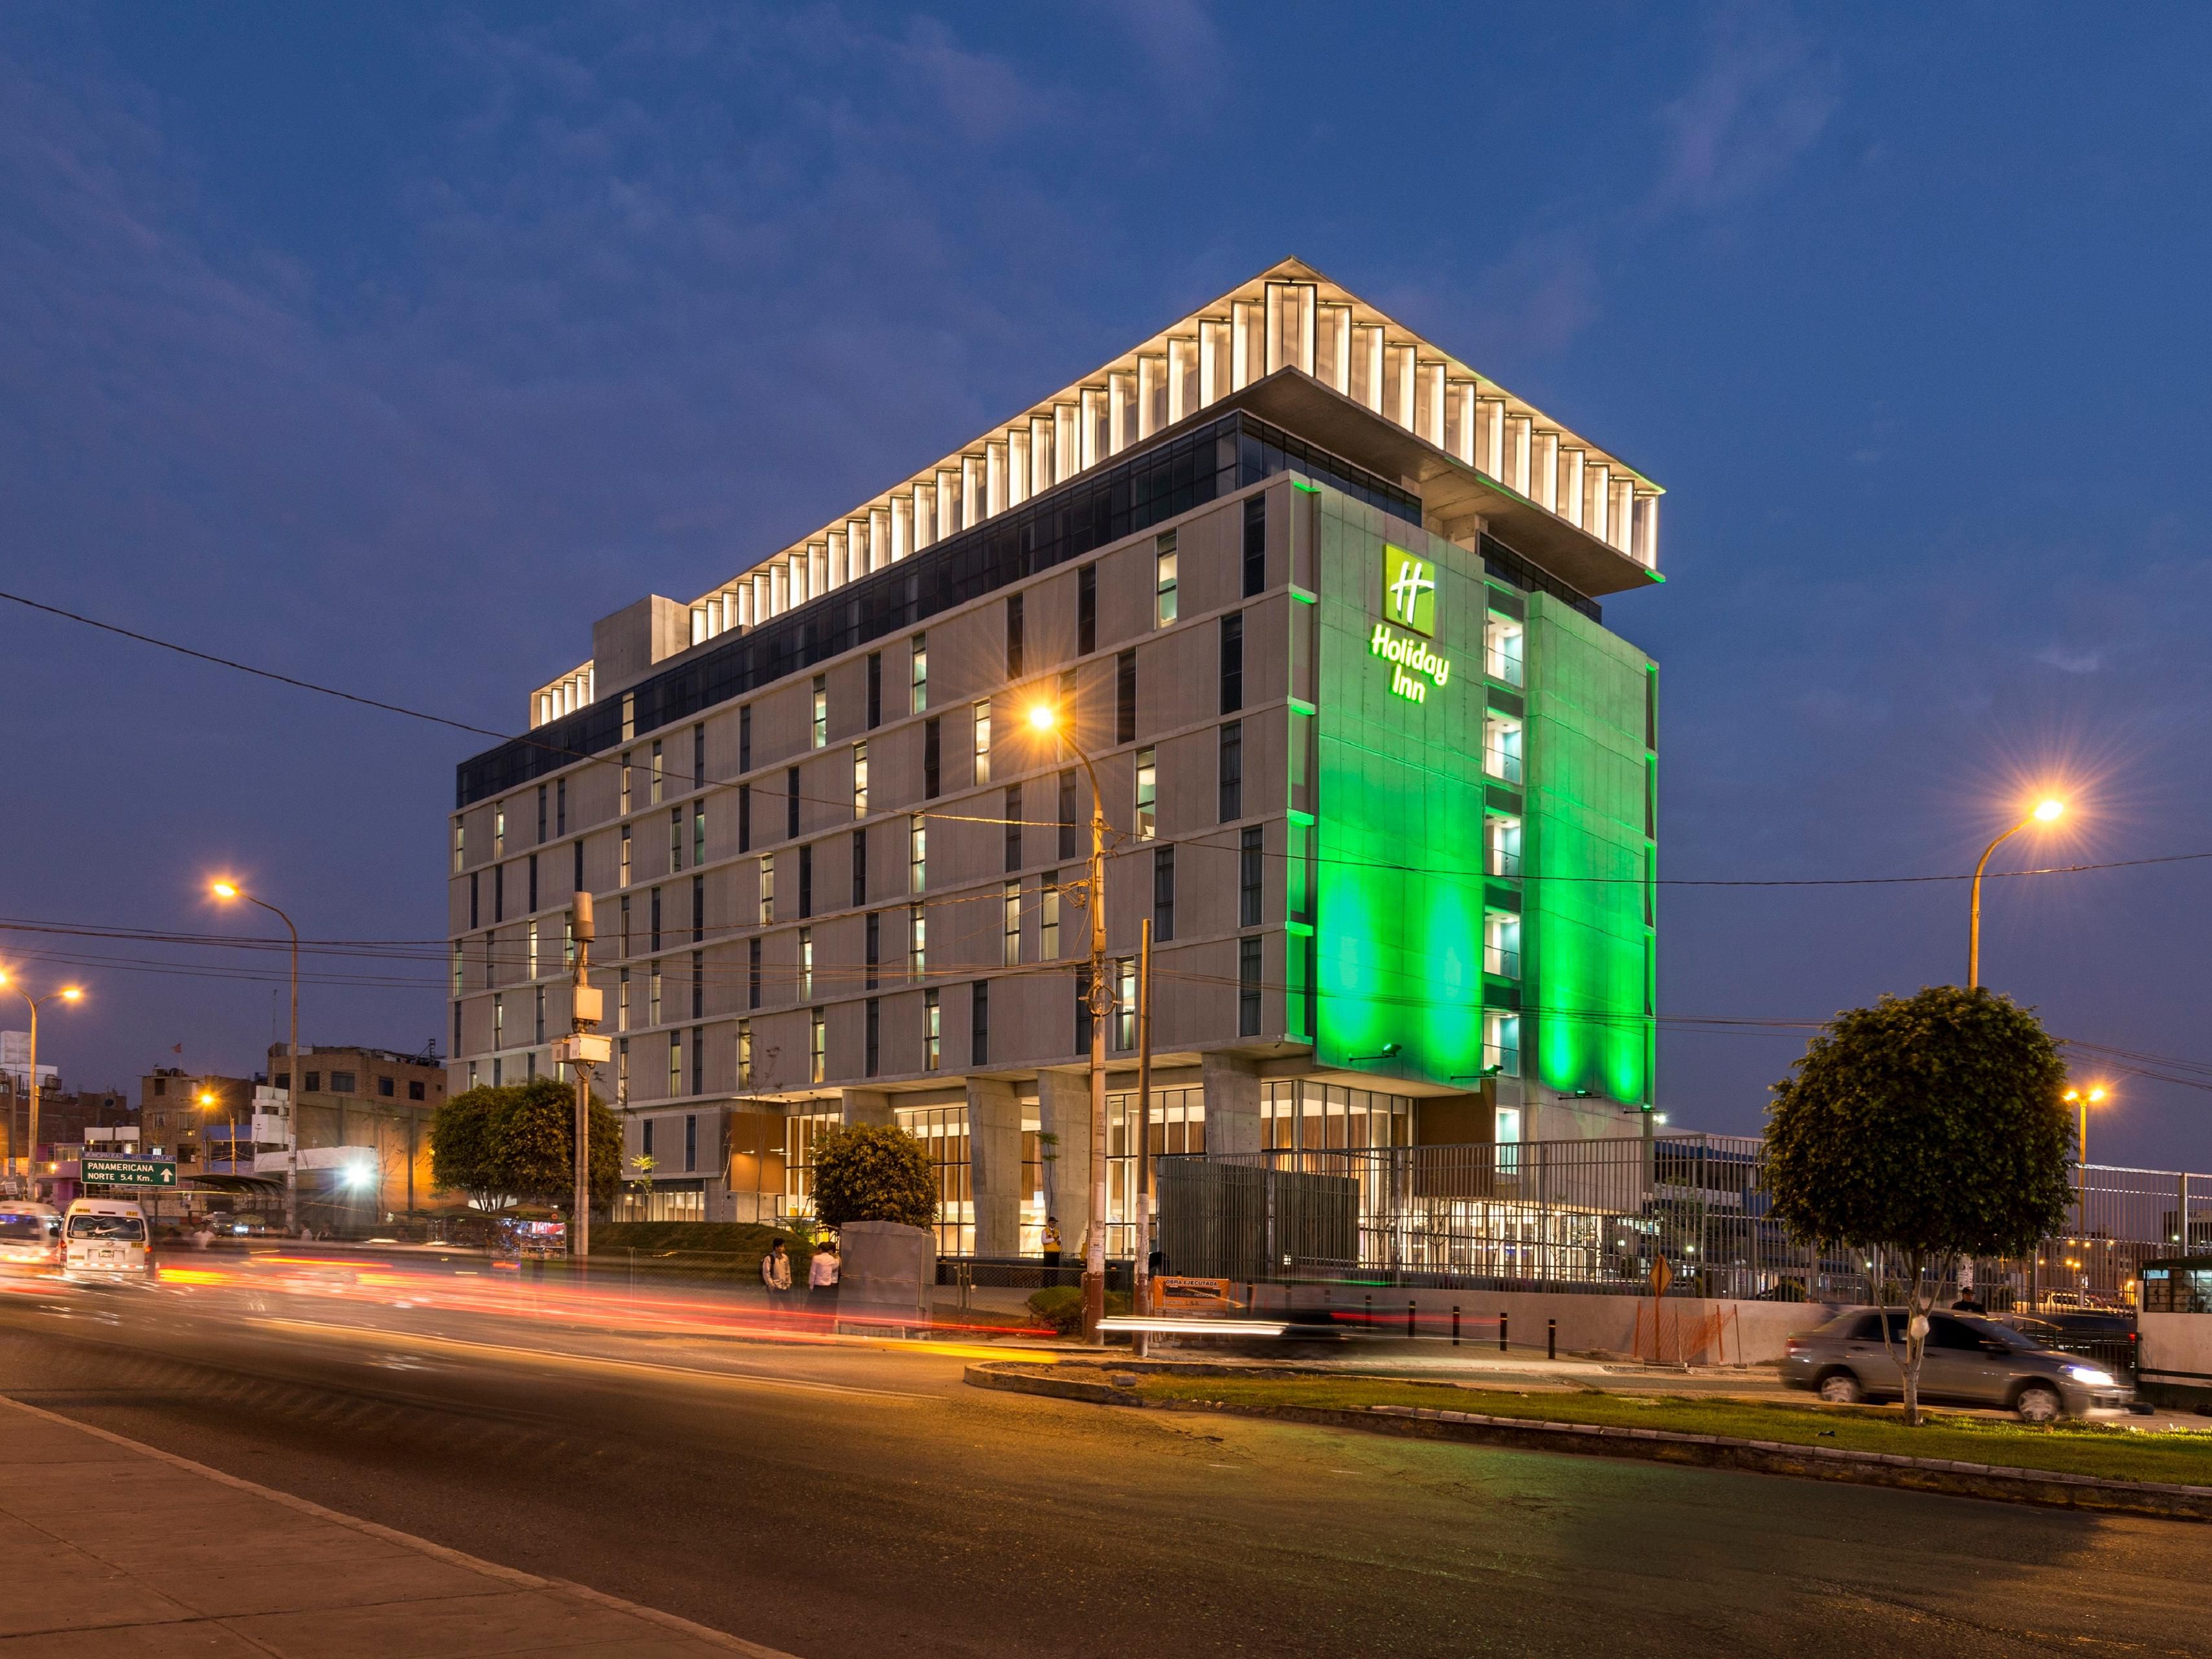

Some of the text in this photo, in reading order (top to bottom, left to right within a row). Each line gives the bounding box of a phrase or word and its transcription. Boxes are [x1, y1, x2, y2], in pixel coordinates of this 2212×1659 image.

[1371, 623, 1450, 686] Holiday
[1392, 663, 1426, 703] Inn
[87, 1162, 154, 1172] PANAMERICANA
